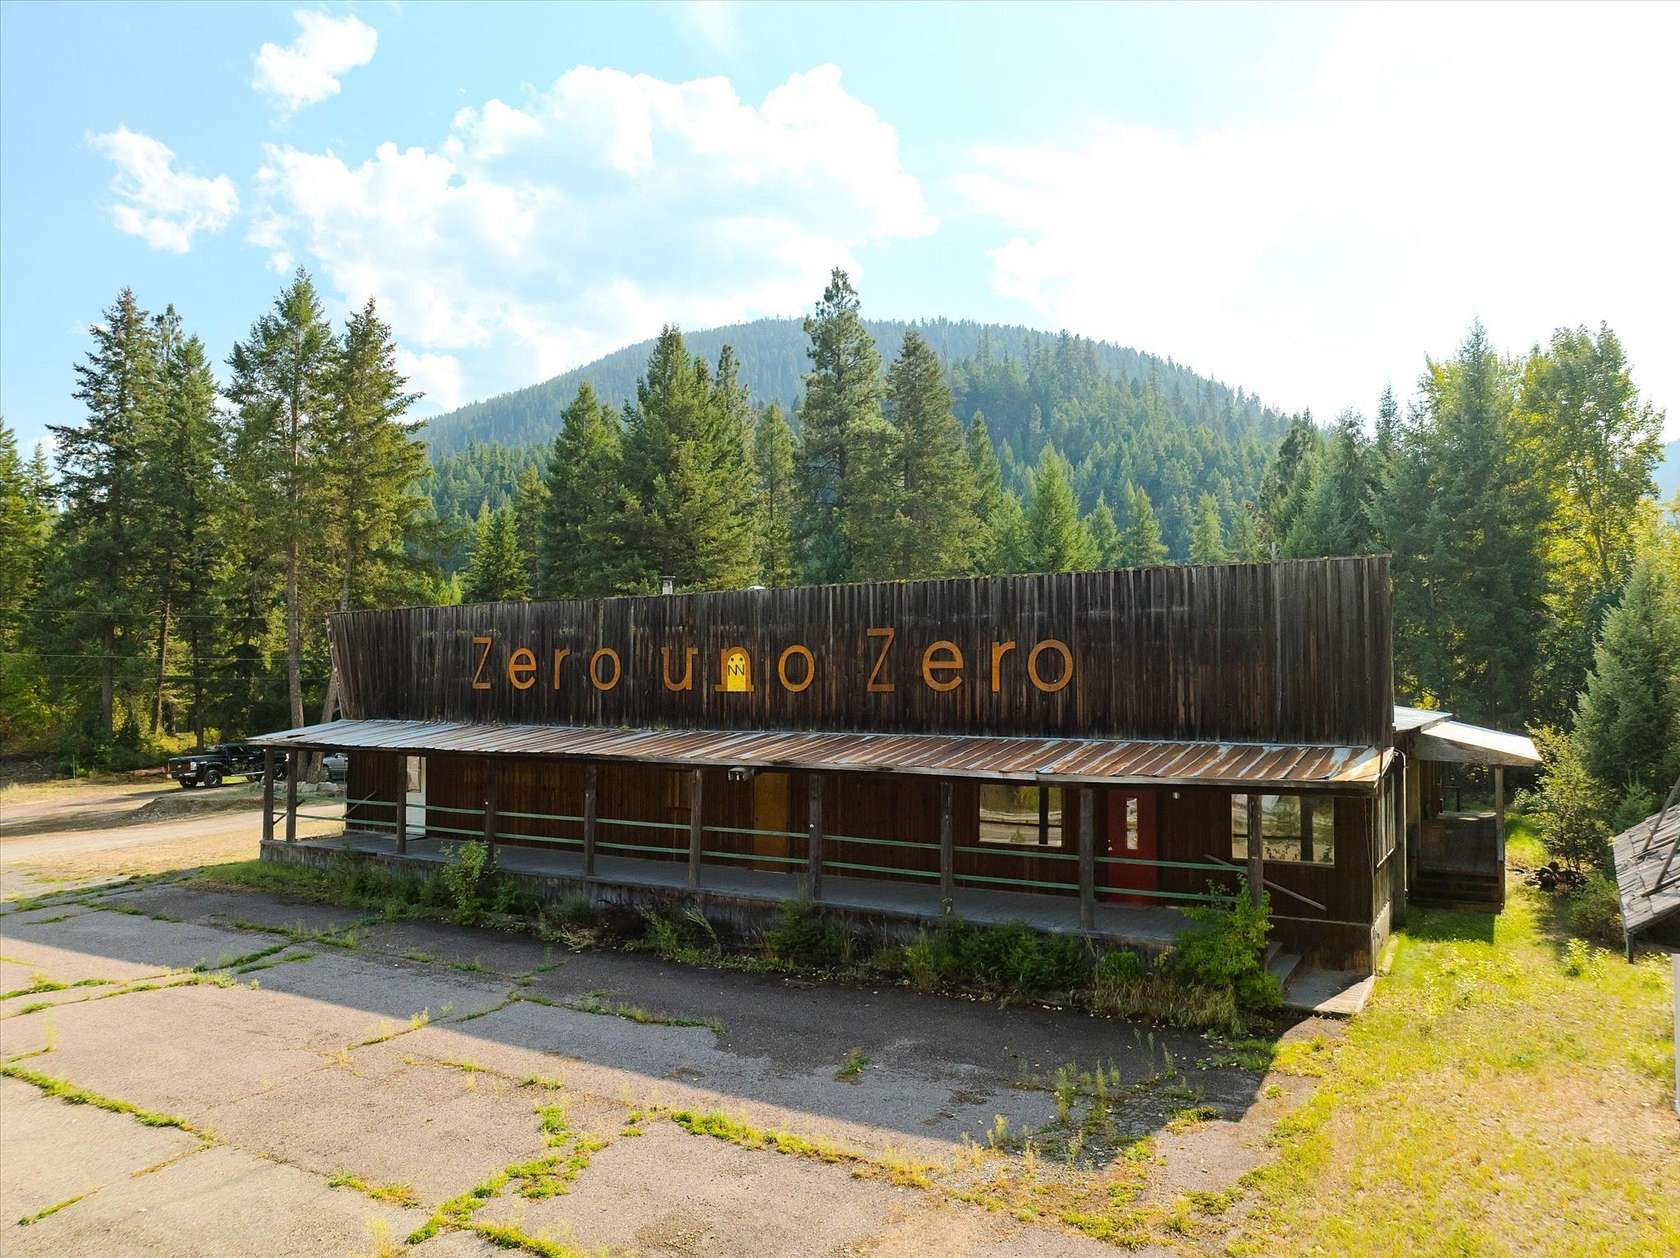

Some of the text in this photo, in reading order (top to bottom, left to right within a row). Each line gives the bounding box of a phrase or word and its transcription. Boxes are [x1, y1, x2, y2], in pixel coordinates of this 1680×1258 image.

[472, 628, 1073, 692] Zero uno Zero
